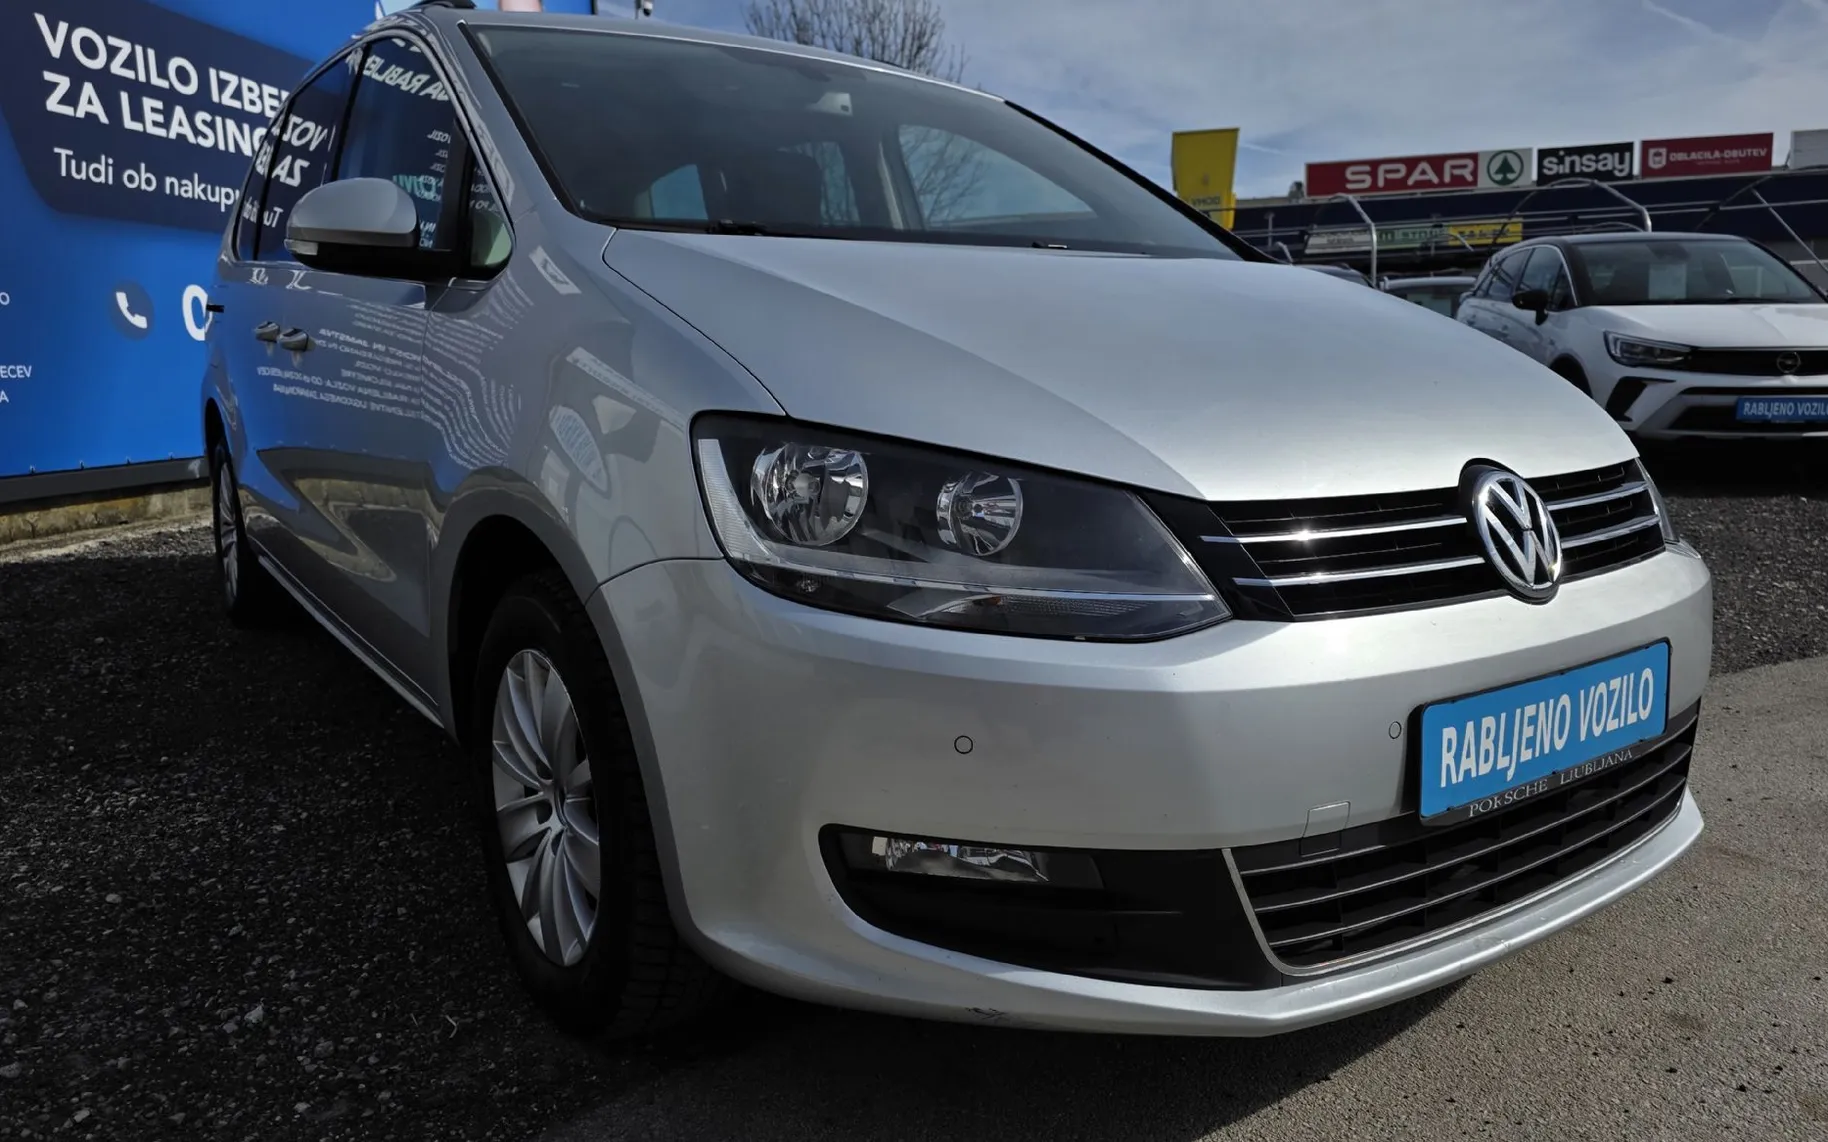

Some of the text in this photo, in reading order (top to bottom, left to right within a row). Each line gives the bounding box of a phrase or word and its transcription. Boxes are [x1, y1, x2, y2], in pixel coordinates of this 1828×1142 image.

[34, 13, 198, 95] VOZILO
[43, 71, 108, 125] ZA
[54, 147, 113, 185] Tudi
[123, 163, 156, 191] ob
[1345, 158, 1475, 189] SPAR
[1542, 151, 1631, 177] sinsay
[1743, 401, 1828, 419] RABLJENO VOZIL
[1440, 667, 1655, 788] RABLJENO VOZILO
[1469, 749, 1634, 817] PORSCHE LJUBLJANA
